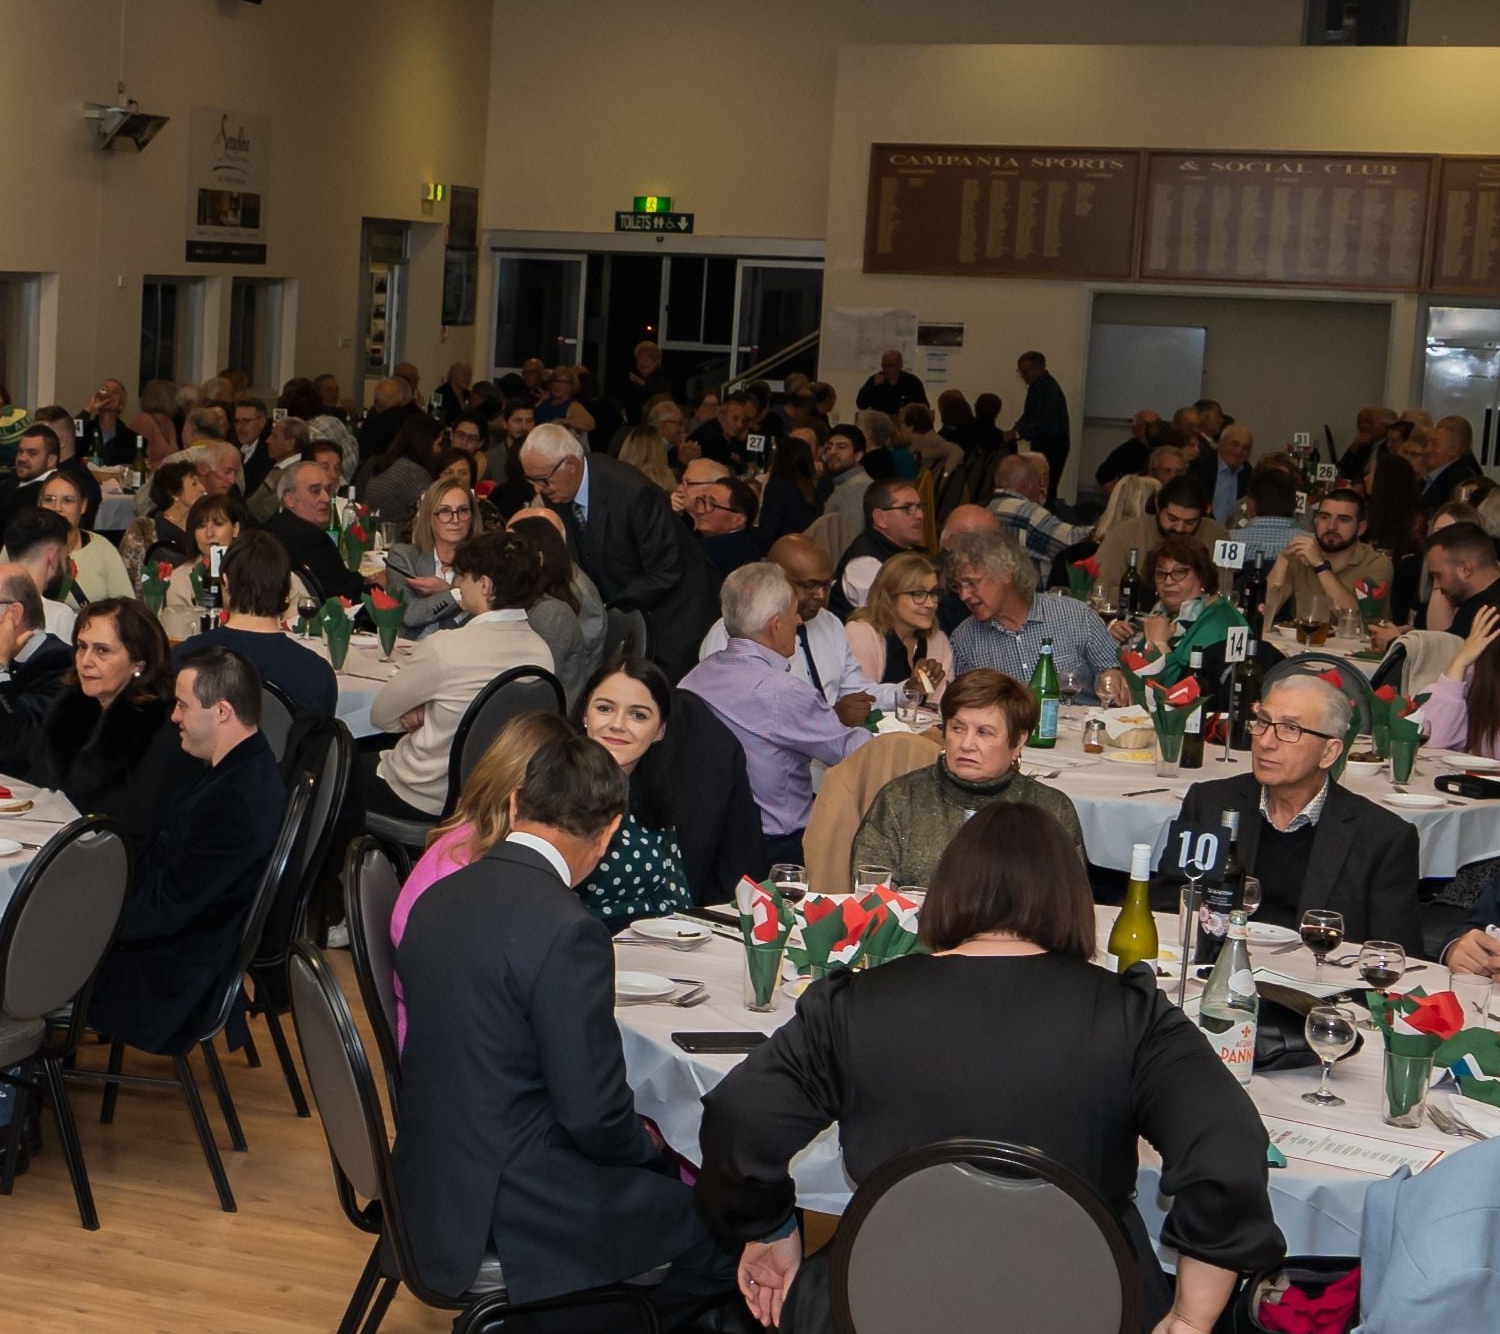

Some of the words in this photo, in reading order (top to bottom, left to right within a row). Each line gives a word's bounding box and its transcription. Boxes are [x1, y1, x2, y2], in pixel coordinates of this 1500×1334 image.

[889, 154, 1020, 168] CAMPANIA
[1031, 157, 1124, 170] SPORTS
[1179, 160, 1201, 172] &
[1211, 162, 1312, 174] SOCIAL
[1324, 164, 1401, 176] CLUB
[619, 214, 652, 230] TOILETS
[750, 437, 763, 448] 27
[1319, 466, 1332, 478] 26
[1220, 543, 1239, 561] 18
[1230, 632, 1244, 657] 14
[1178, 831, 1219, 871] 10
[1220, 1046, 1254, 1064] PANN
